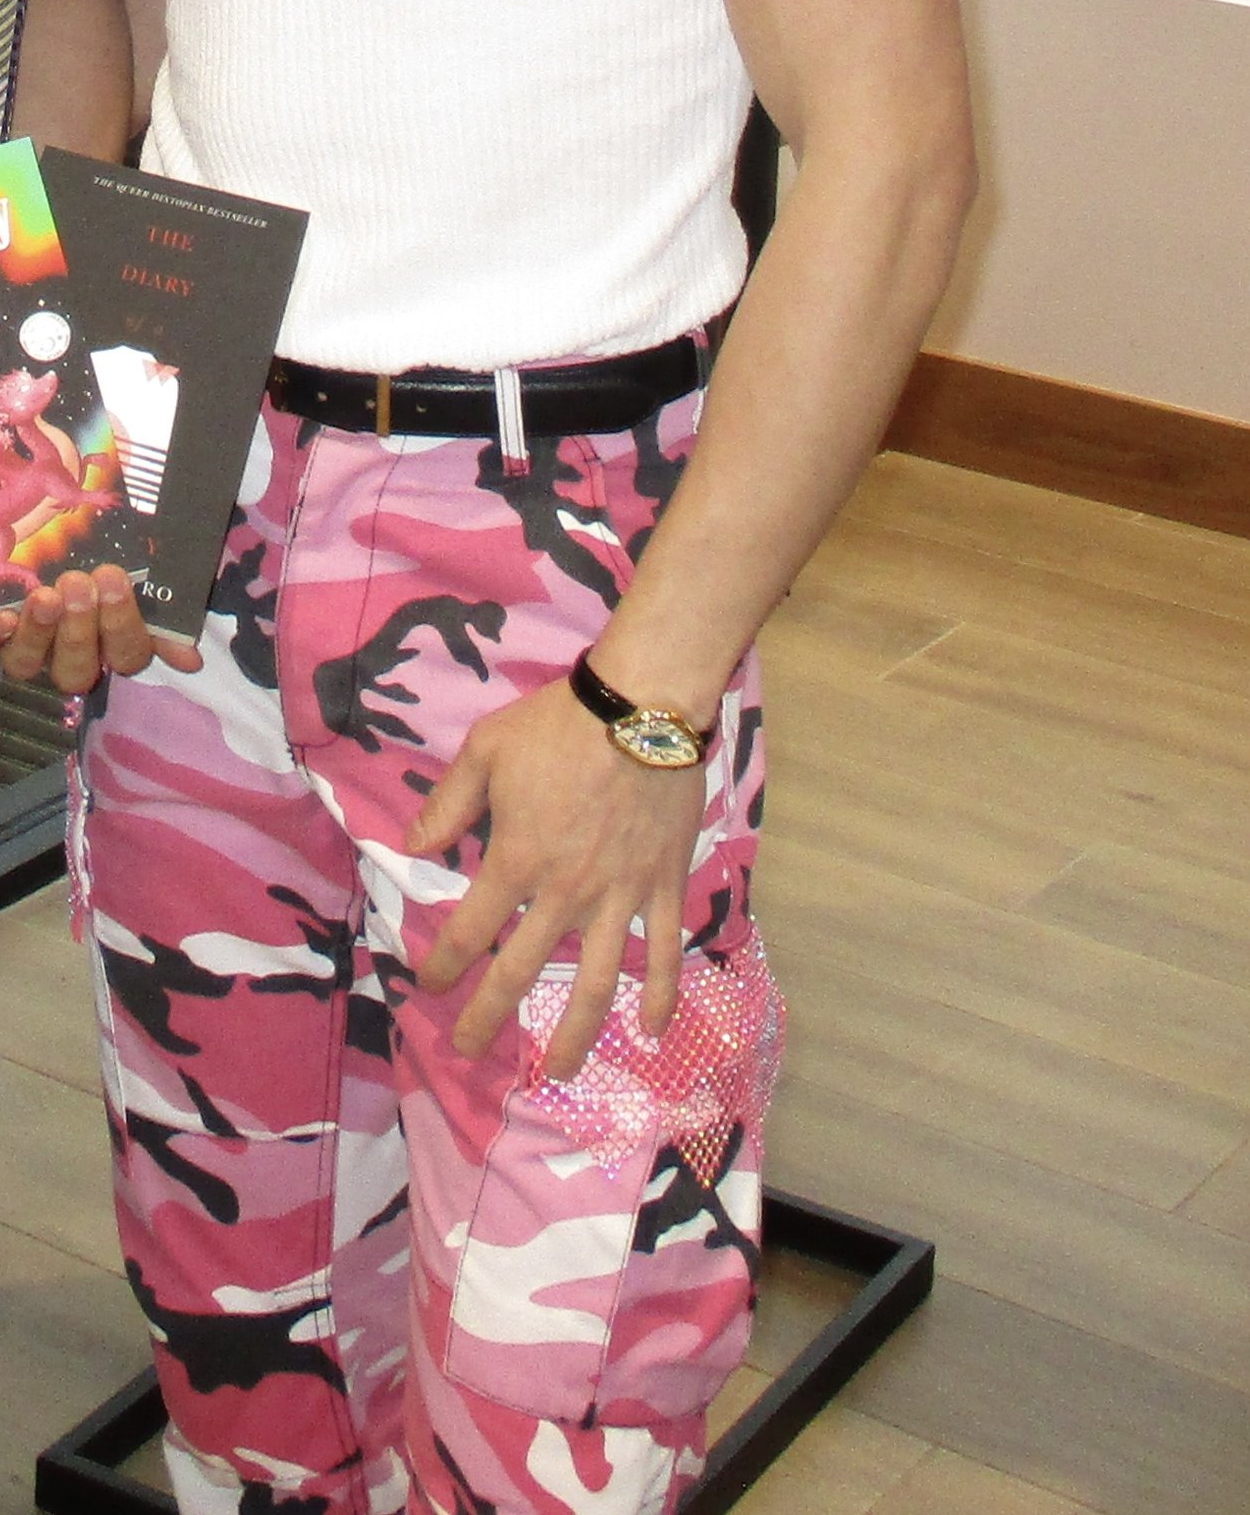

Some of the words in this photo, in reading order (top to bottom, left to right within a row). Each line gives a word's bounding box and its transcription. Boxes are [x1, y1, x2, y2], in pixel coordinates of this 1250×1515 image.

[93, 175, 113, 189] THE
[115, 184, 150, 200] QUEER
[206, 205, 269, 229] BESTSELLER
[147, 225, 194, 253] THE
[121, 263, 195, 297] DIARY
